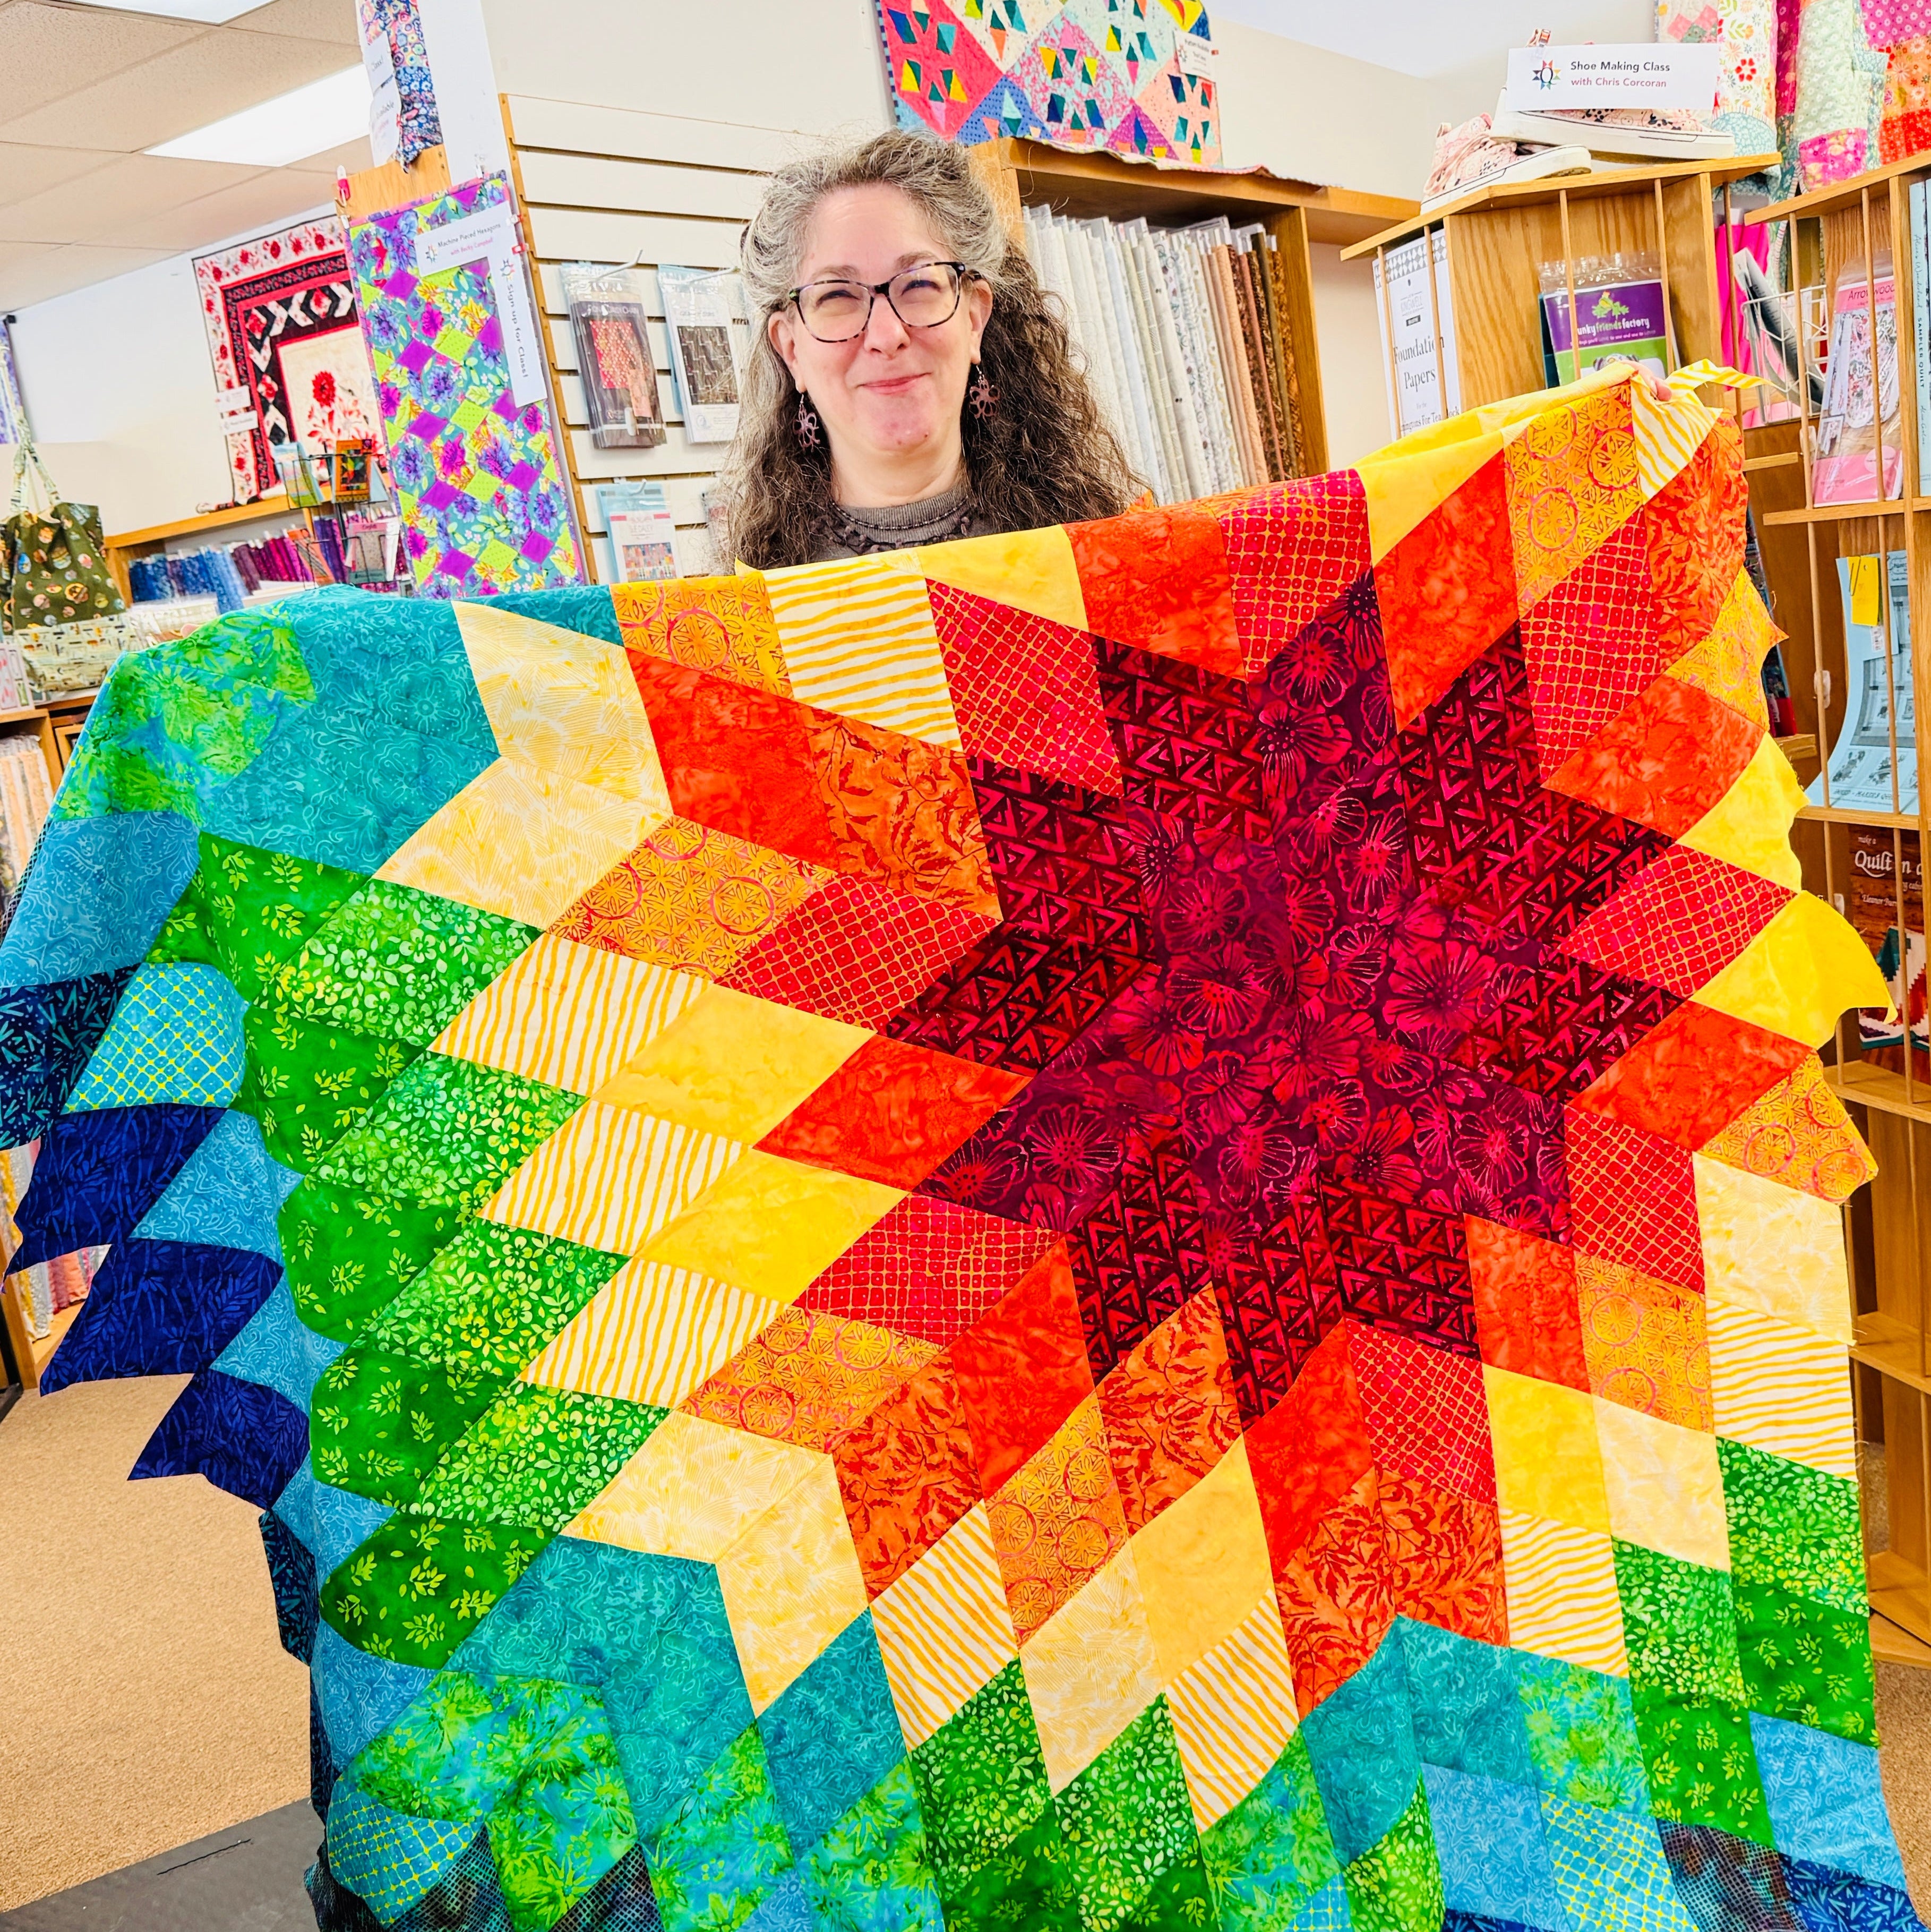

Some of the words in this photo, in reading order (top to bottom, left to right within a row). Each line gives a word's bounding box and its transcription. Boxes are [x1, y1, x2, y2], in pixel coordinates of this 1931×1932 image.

[1570, 61, 1597, 71] Shoe
[1600, 61, 1640, 73] Making
[1643, 61, 1671, 72] Class
[1571, 77, 1592, 86] with
[1595, 78, 1620, 87] Chris
[1623, 78, 1667, 88] Corcoran
[507, 284, 516, 310] Sign
[512, 311, 518, 324] up
[518, 346, 529, 378] Class!
[1404, 369, 1436, 392] Papers
[1855, 850, 1894, 878] Quilt
[1901, 860, 1912, 874] n
